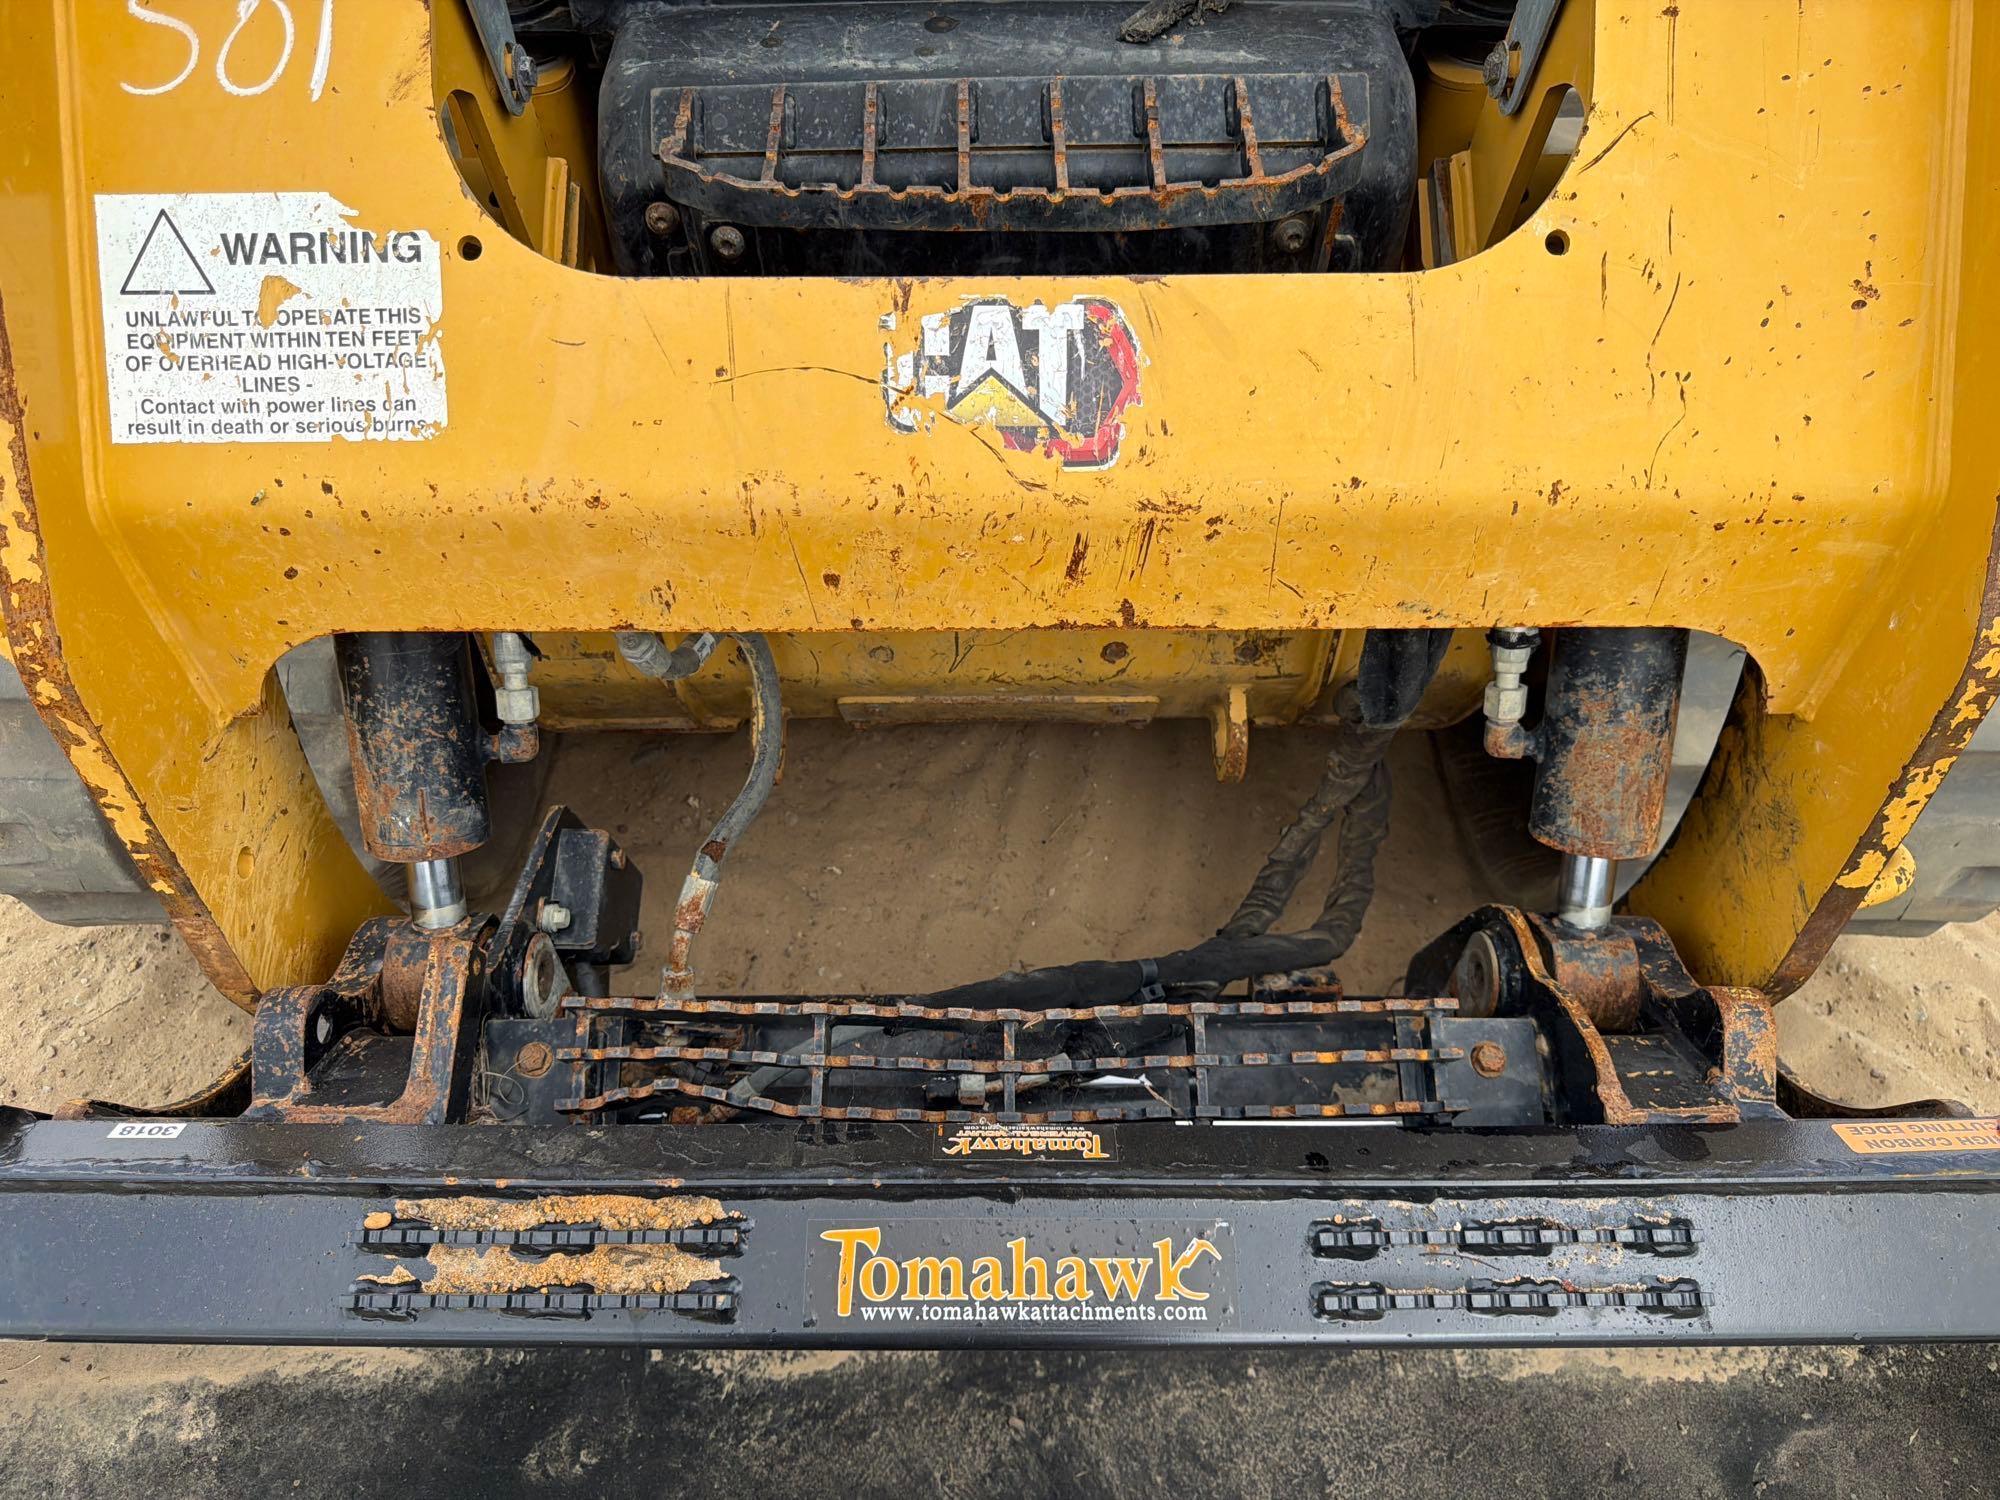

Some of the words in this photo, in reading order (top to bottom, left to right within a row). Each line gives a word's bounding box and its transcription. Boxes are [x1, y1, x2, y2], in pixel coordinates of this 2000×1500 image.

[220, 230, 422, 266] WARNING
[126, 310, 239, 327] UNLAWFUL
[276, 308, 371, 326] OPERATE
[375, 307, 421, 324] THIS
[249, 332, 321, 348] WITHIN
[325, 331, 365, 347] TEN
[372, 330, 422, 346] FEET
[126, 355, 152, 372] OF
[158, 354, 271, 371] OVERHEAD
[277, 352, 427, 370] HIGH-VOLTAGE
[242, 376, 300, 393] LINES
[141, 398, 215, 414] Contact
[221, 398, 260, 413] with
[267, 401, 324, 417] power
[330, 397, 376, 412] lines
[382, 399, 417, 412] can
[128, 419, 181, 435] result
[188, 420, 205, 434] in
[211, 418, 264, 434] death
[270, 422, 289, 434] or
[295, 419, 365, 434] serious
[373, 417, 426, 433] burns
[118, 1125, 178, 1136] 3018
[1848, 1125, 1905, 1136] EDGE
[1909, 1122, 1995, 1134] CUTTING
[1864, 1136, 1952, 1150] CARBON
[860, 1302, 1208, 1321] www.tomahawkattachments.com
